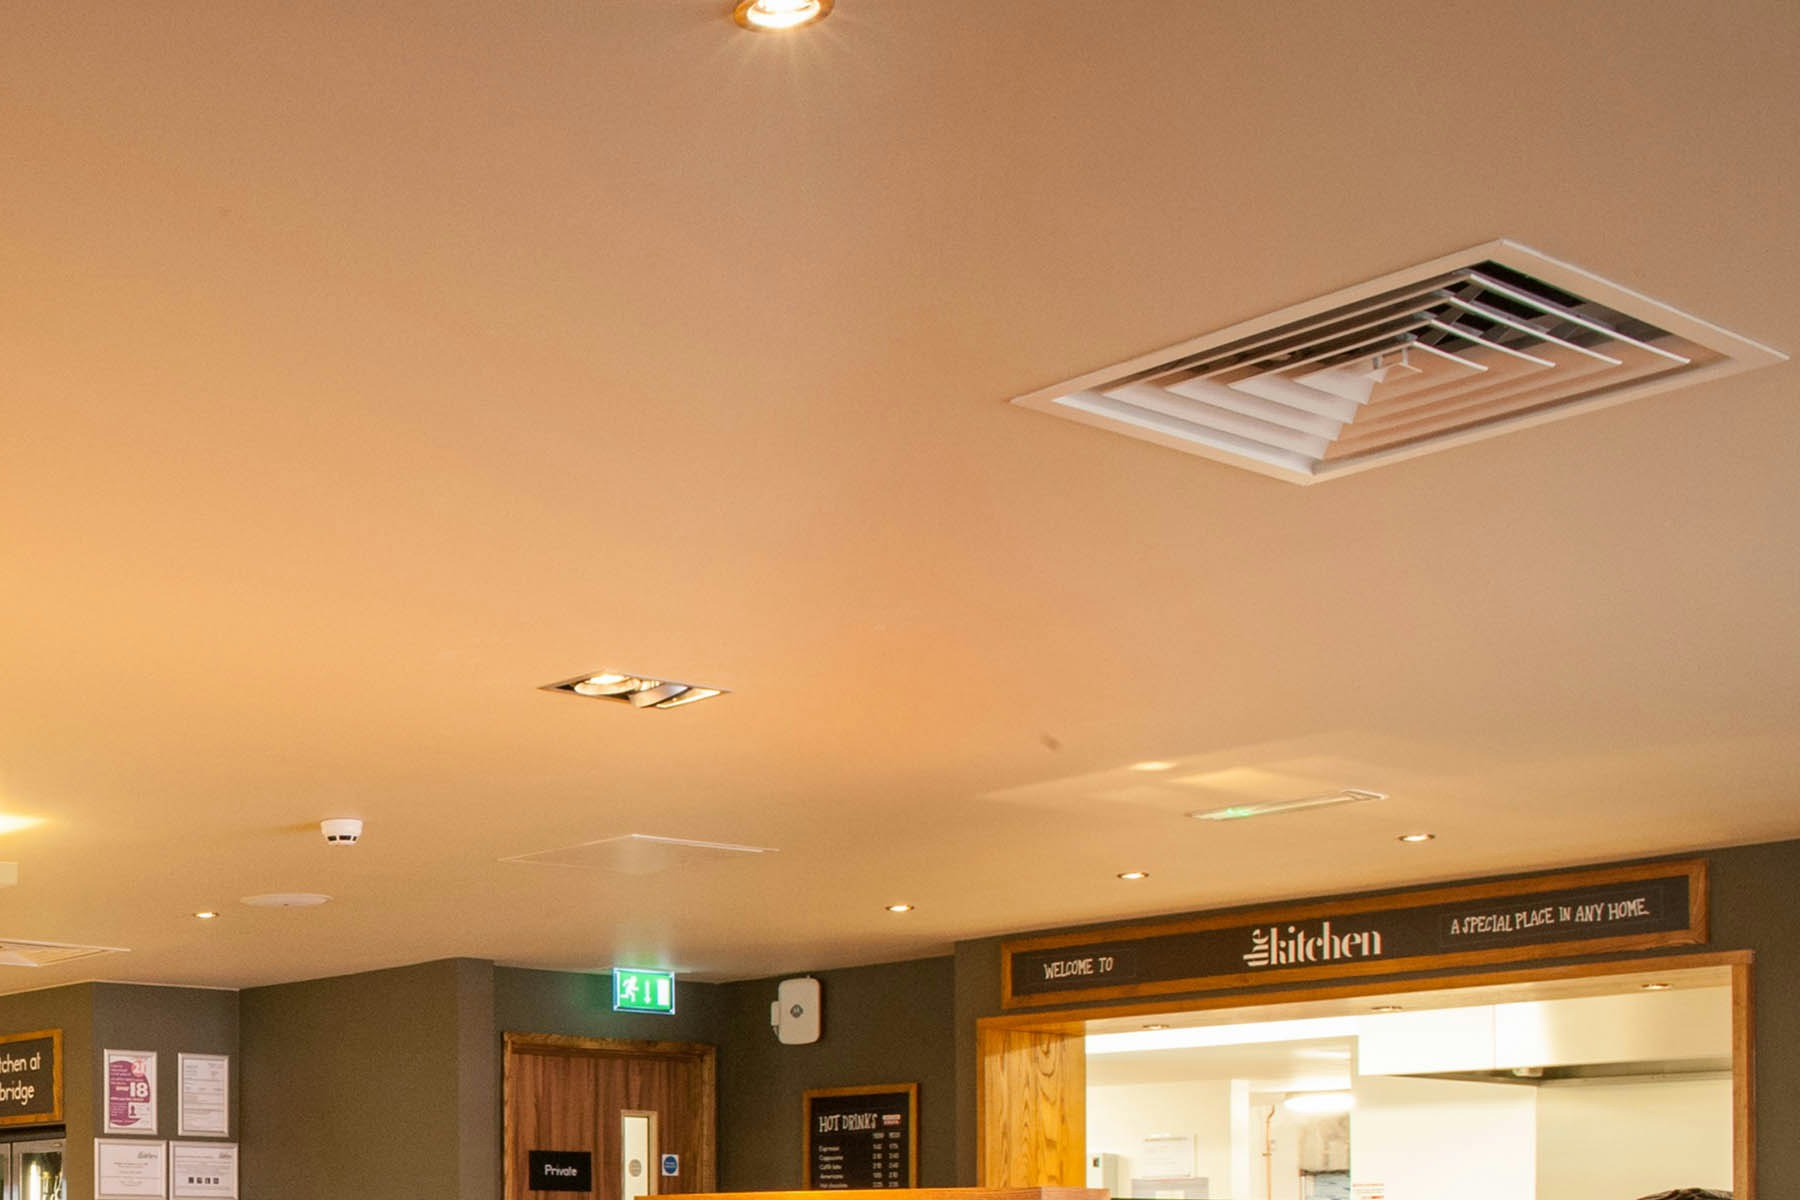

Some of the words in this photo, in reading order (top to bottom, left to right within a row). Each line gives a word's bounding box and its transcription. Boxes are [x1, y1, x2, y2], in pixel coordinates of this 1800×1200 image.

[1451, 919, 1460, 935] A
[1462, 914, 1513, 933] SPECIAL
[1515, 907, 1554, 930] PLACE
[1559, 907, 1572, 921] IN
[1575, 903, 1605, 922] ANY
[1271, 921, 1381, 966] kitchen
[1043, 958, 1093, 979] WELCOME
[1099, 956, 1114, 972] TO
[29, 1051, 42, 1071] at
[130, 1082, 149, 1098] 18
[818, 1114, 840, 1132] HOT
[842, 1112, 878, 1131] DRINKS
[544, 1164, 578, 1177] Private
